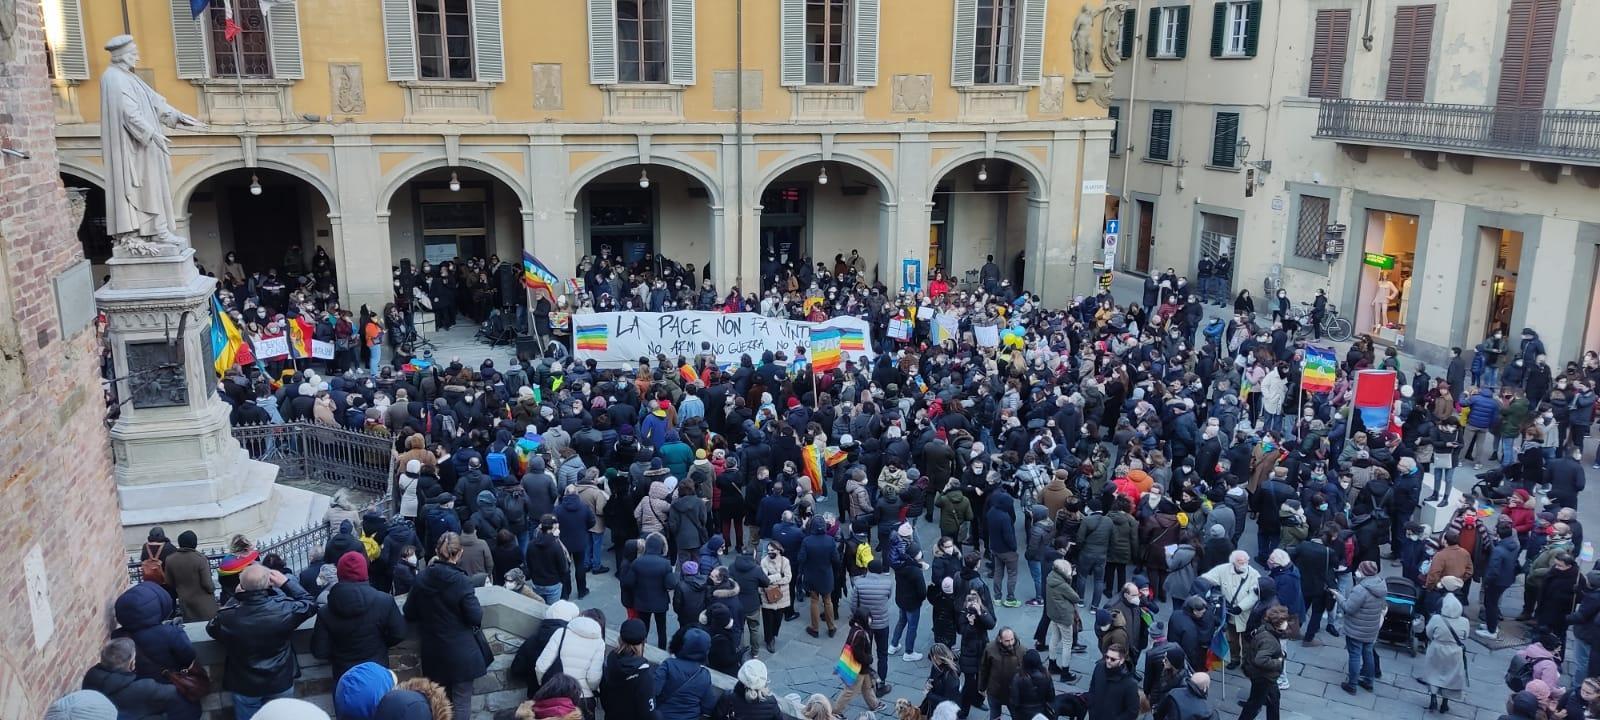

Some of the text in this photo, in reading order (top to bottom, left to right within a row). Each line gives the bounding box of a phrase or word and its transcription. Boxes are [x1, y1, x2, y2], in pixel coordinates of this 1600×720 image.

[616, 315, 640, 340] LA
[658, 315, 701, 339] PACE
[716, 315, 741, 338] NON
[752, 317, 770, 336] FA
[648, 341, 662, 355] NO
[670, 340, 696, 355] ARMI
[712, 342, 725, 356] NO
[728, 339, 765, 354] GUERRA
[776, 340, 789, 350] NO
